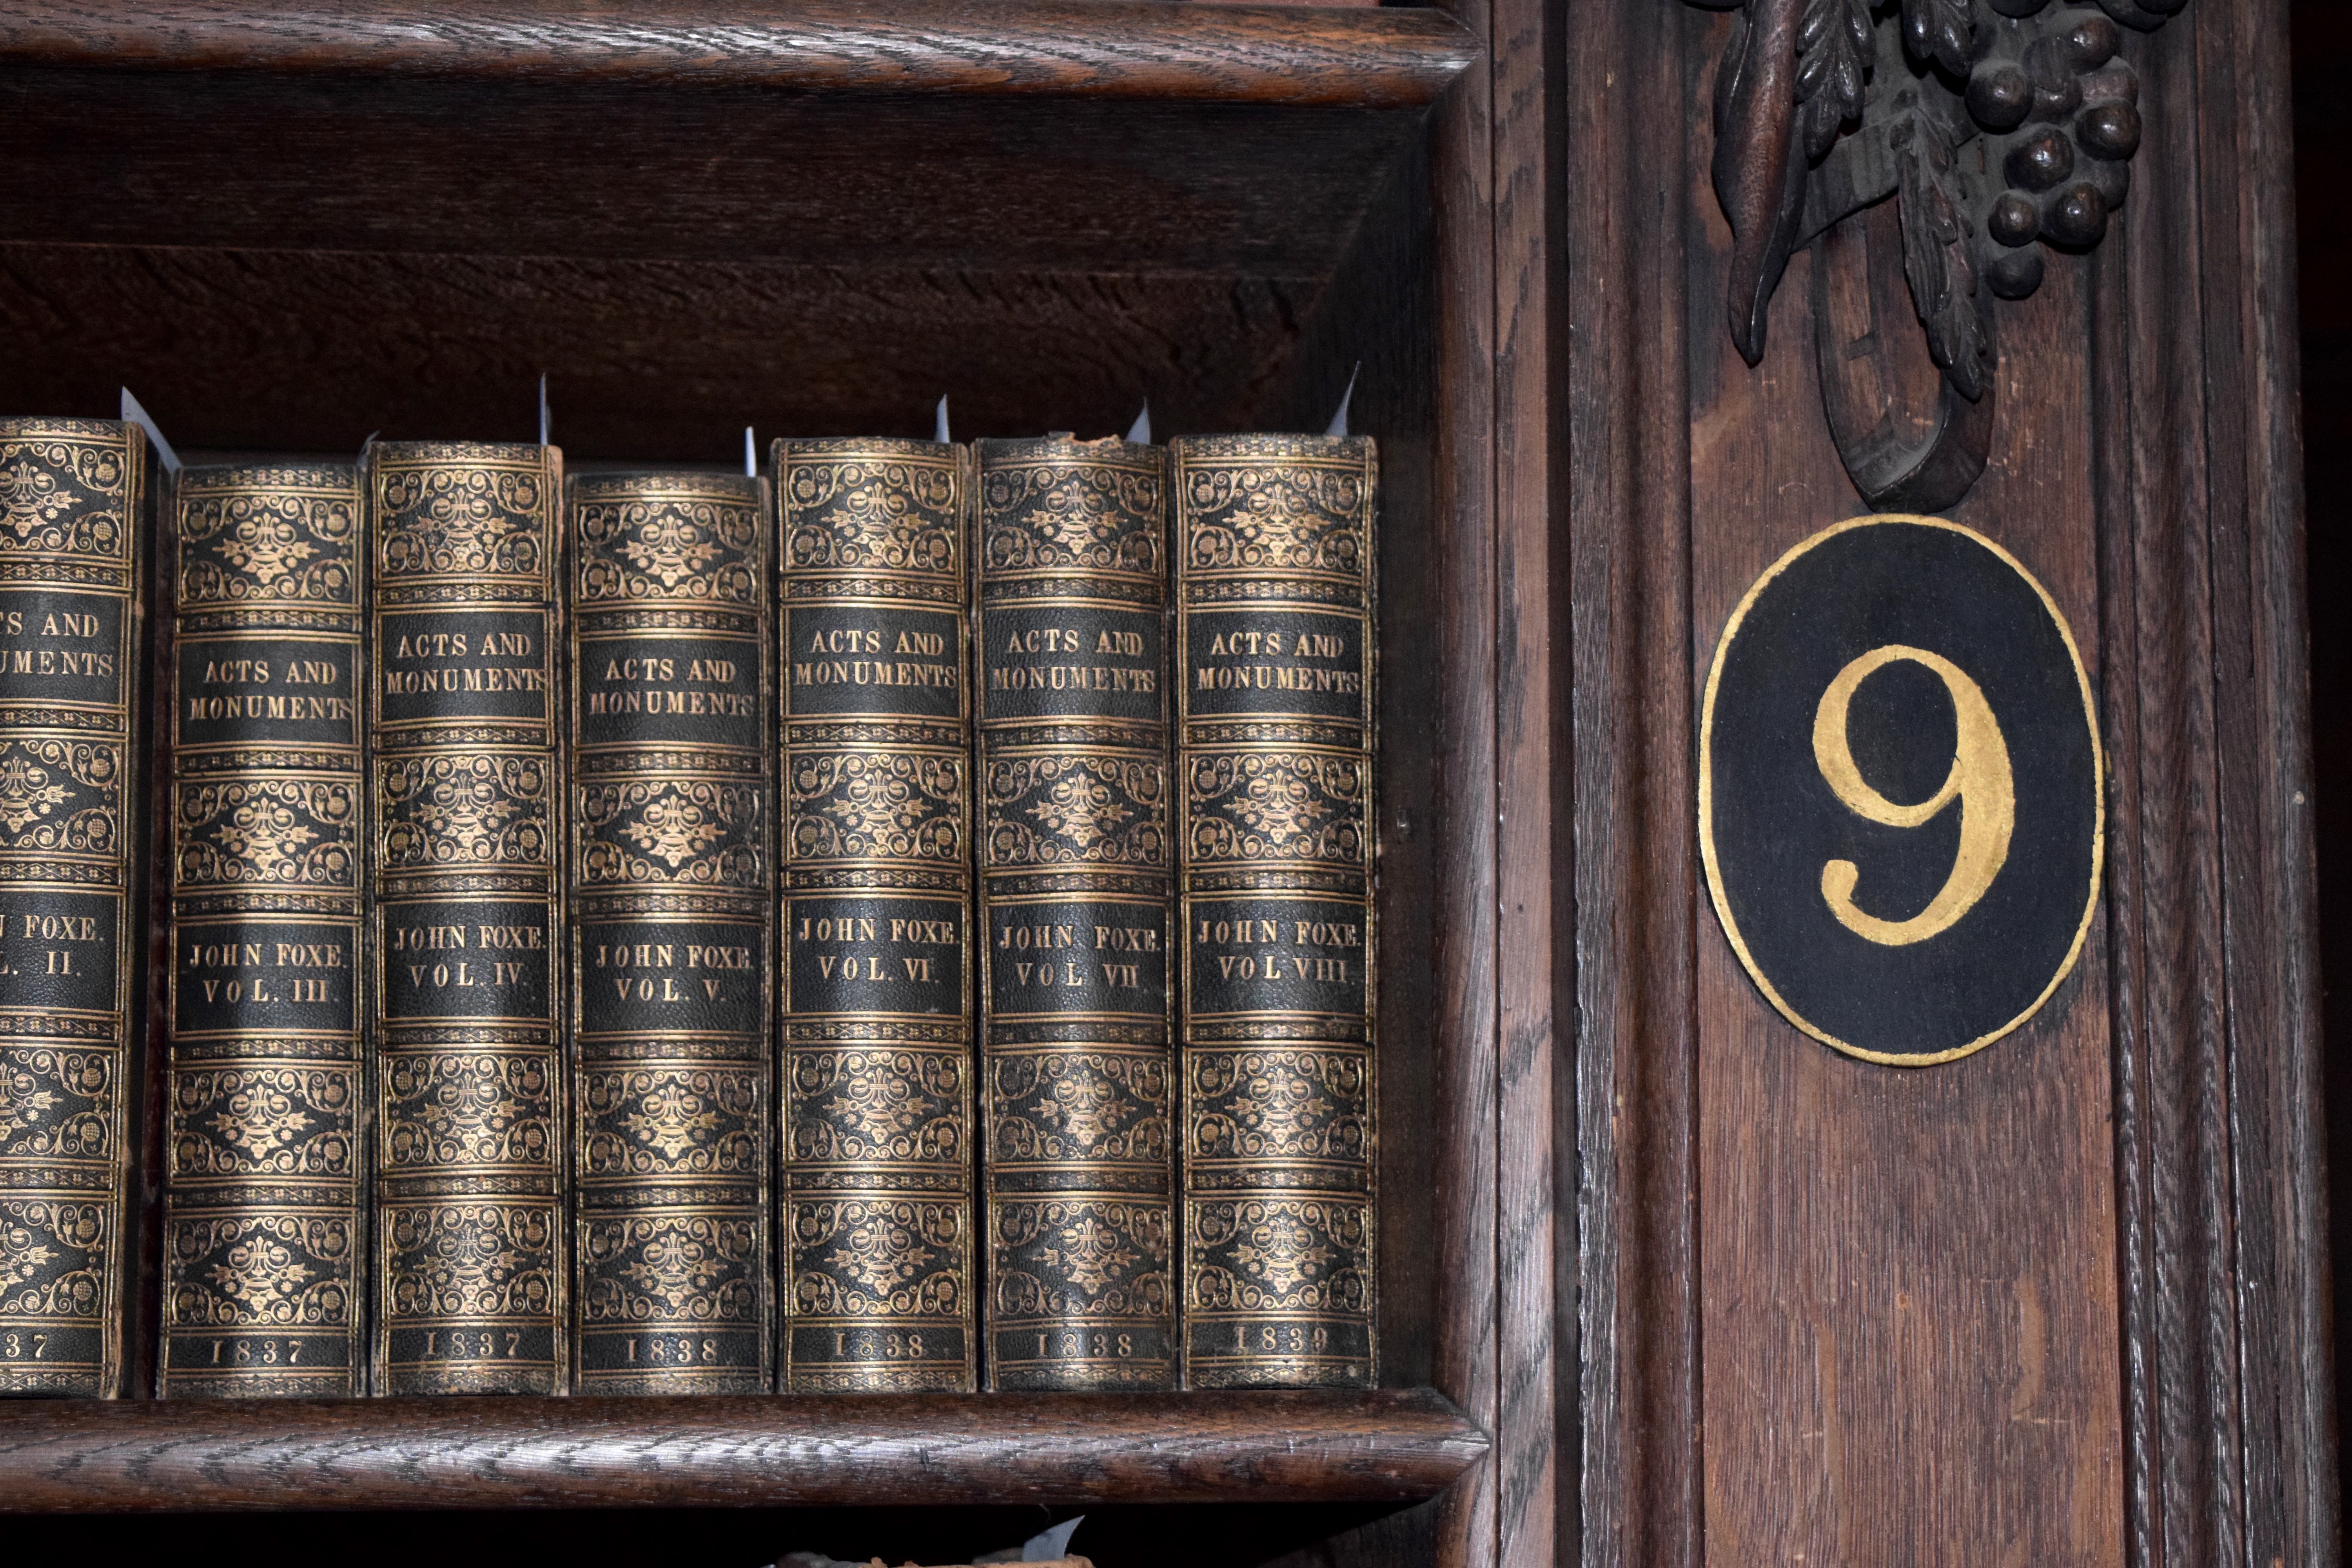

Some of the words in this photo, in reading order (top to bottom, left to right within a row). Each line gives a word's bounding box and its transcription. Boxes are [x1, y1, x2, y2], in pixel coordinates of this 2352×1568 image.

[41, 613, 99, 637] AND
[397, 634, 466, 658] ACTS
[481, 633, 530, 656] AND
[811, 630, 881, 654] ACTS
[894, 631, 944, 656] AND
[1007, 629, 1079, 653] ACTS
[1095, 630, 1143, 657] AND
[1211, 632, 1281, 656] ACTS
[1294, 634, 1344, 658] AND
[203, 660, 269, 684] ACTS
[286, 661, 337, 684] AND
[387, 668, 547, 694] MONUMENTS
[605, 658, 673, 681] ACTS
[686, 659, 736, 682] AND
[794, 661, 957, 688] MONUMENTS
[992, 666, 1156, 693] MONUMENTS
[1197, 666, 1360, 694] MONUMENTS
[189, 695, 353, 720] MONUMENTS
[589, 690, 753, 716] MONUMENTS
[1813, 644, 2015, 946] 9
[23, 915, 104, 940] FOXE.
[394, 926, 466, 951] JOHN
[479, 926, 547, 949] FOXE.
[799, 918, 875, 941] JOHN
[890, 919, 960, 944] FOXE.
[1000, 926, 1074, 949] JOHN
[1094, 926, 1161, 952] FOXE.
[1199, 920, 1278, 944] JOHN
[1295, 921, 1361, 946] FOXE.
[45, 951, 81, 976] II.
[189, 944, 262, 967] JOHN
[275, 943, 347, 969] FOXE.
[596, 944, 673, 967] JOHN
[408, 963, 485, 988] VOL.
[818, 956, 892, 982] VOL.
[902, 958, 939, 984] VI.
[203, 979, 279, 1003] VOL.
[292, 979, 339, 1002] III.
[615, 978, 690, 1002] VOL.
[702, 979, 726, 1002] V.
[428, 1333, 519, 1357] 1837
[628, 1339, 717, 1362] 1838
[835, 1333, 922, 1357] 1838
[1038, 1334, 1131, 1357] 1838
[1234, 1327, 1328, 1350] 1839
[211, 1340, 303, 1363] 1837
